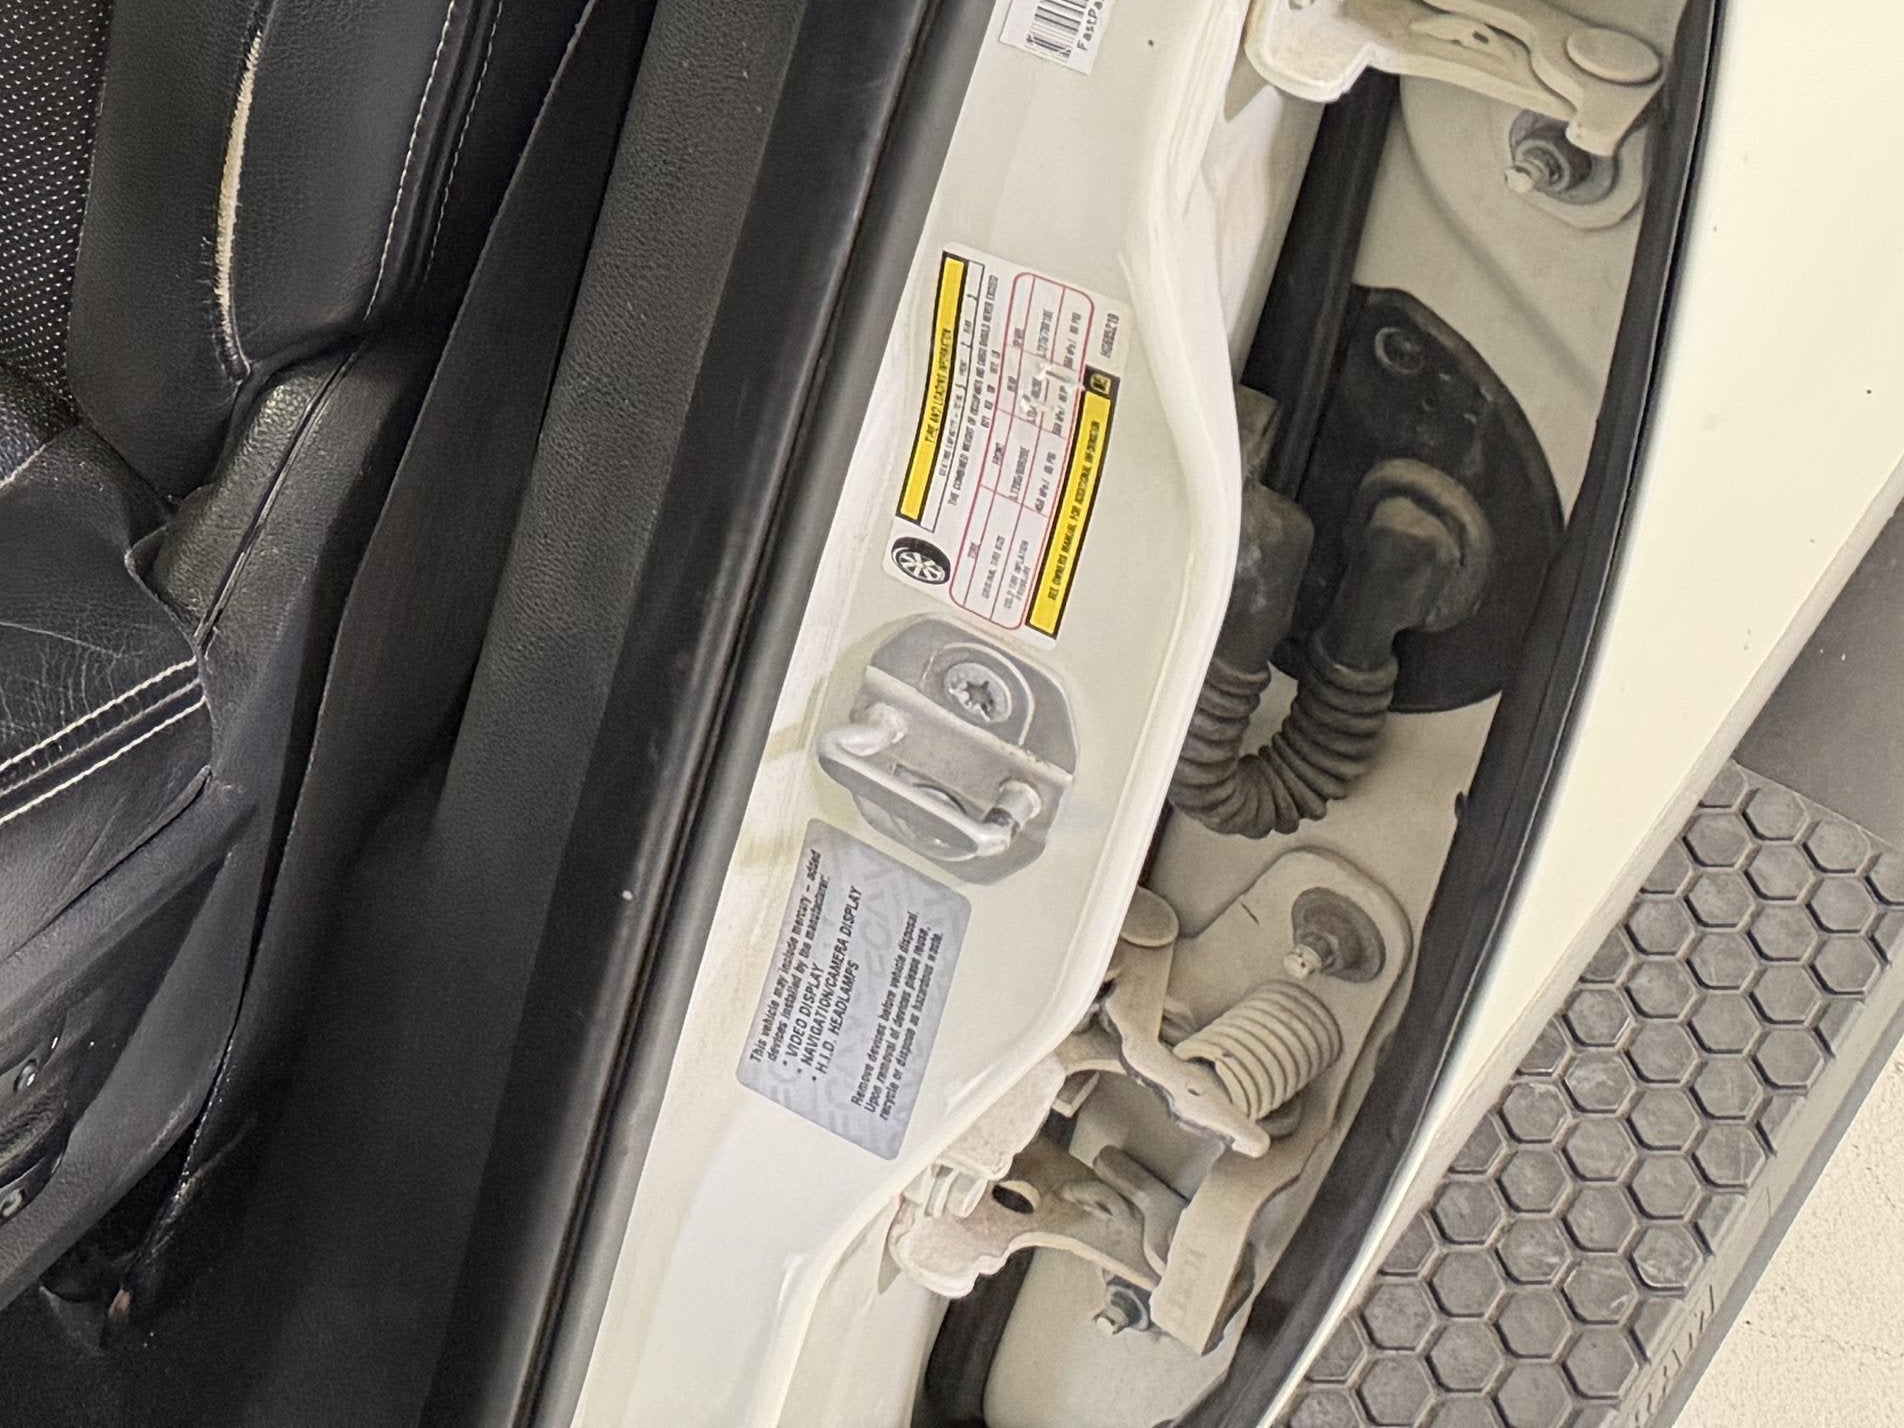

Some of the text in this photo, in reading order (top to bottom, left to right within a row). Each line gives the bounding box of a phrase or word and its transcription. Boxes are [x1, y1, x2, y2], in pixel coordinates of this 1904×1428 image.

[806, 850, 821, 880] added
[792, 897, 811, 935] mercury
[778, 937, 797, 974] include
[793, 960, 808, 974] by
[798, 942, 811, 958] the
[773, 976, 788, 998] may
[800, 885, 862, 1066] NAVIGATION/CAMERA DISPLAY
[904, 957, 921, 990] please
[911, 964, 933, 1011] hazardous
[781, 974, 801, 1019] installed
[786, 962, 824, 1057] VIDEO DISPLAY
[892, 990, 911, 1028] devices
[761, 1000, 779, 1037] vehicle
[815, 960, 859, 1074] H.I.D. HEADLAMPS
[851, 1064, 873, 1106] Remove
[867, 1023, 886, 1062] devices
[878, 990, 895, 1021] before
[890, 954, 906, 988] vehicle
[889, 1027, 899, 1040] of
[910, 1014, 919, 1026] as
[750, 1040, 765, 1062] This
[767, 1020, 786, 1061] devices
[895, 1028, 916, 1067] dispose
[876, 1040, 895, 1083] removal
[892, 1068, 902, 1080] or
[864, 1085, 882, 1113] Upon
[879, 1082, 899, 1121] recycle
